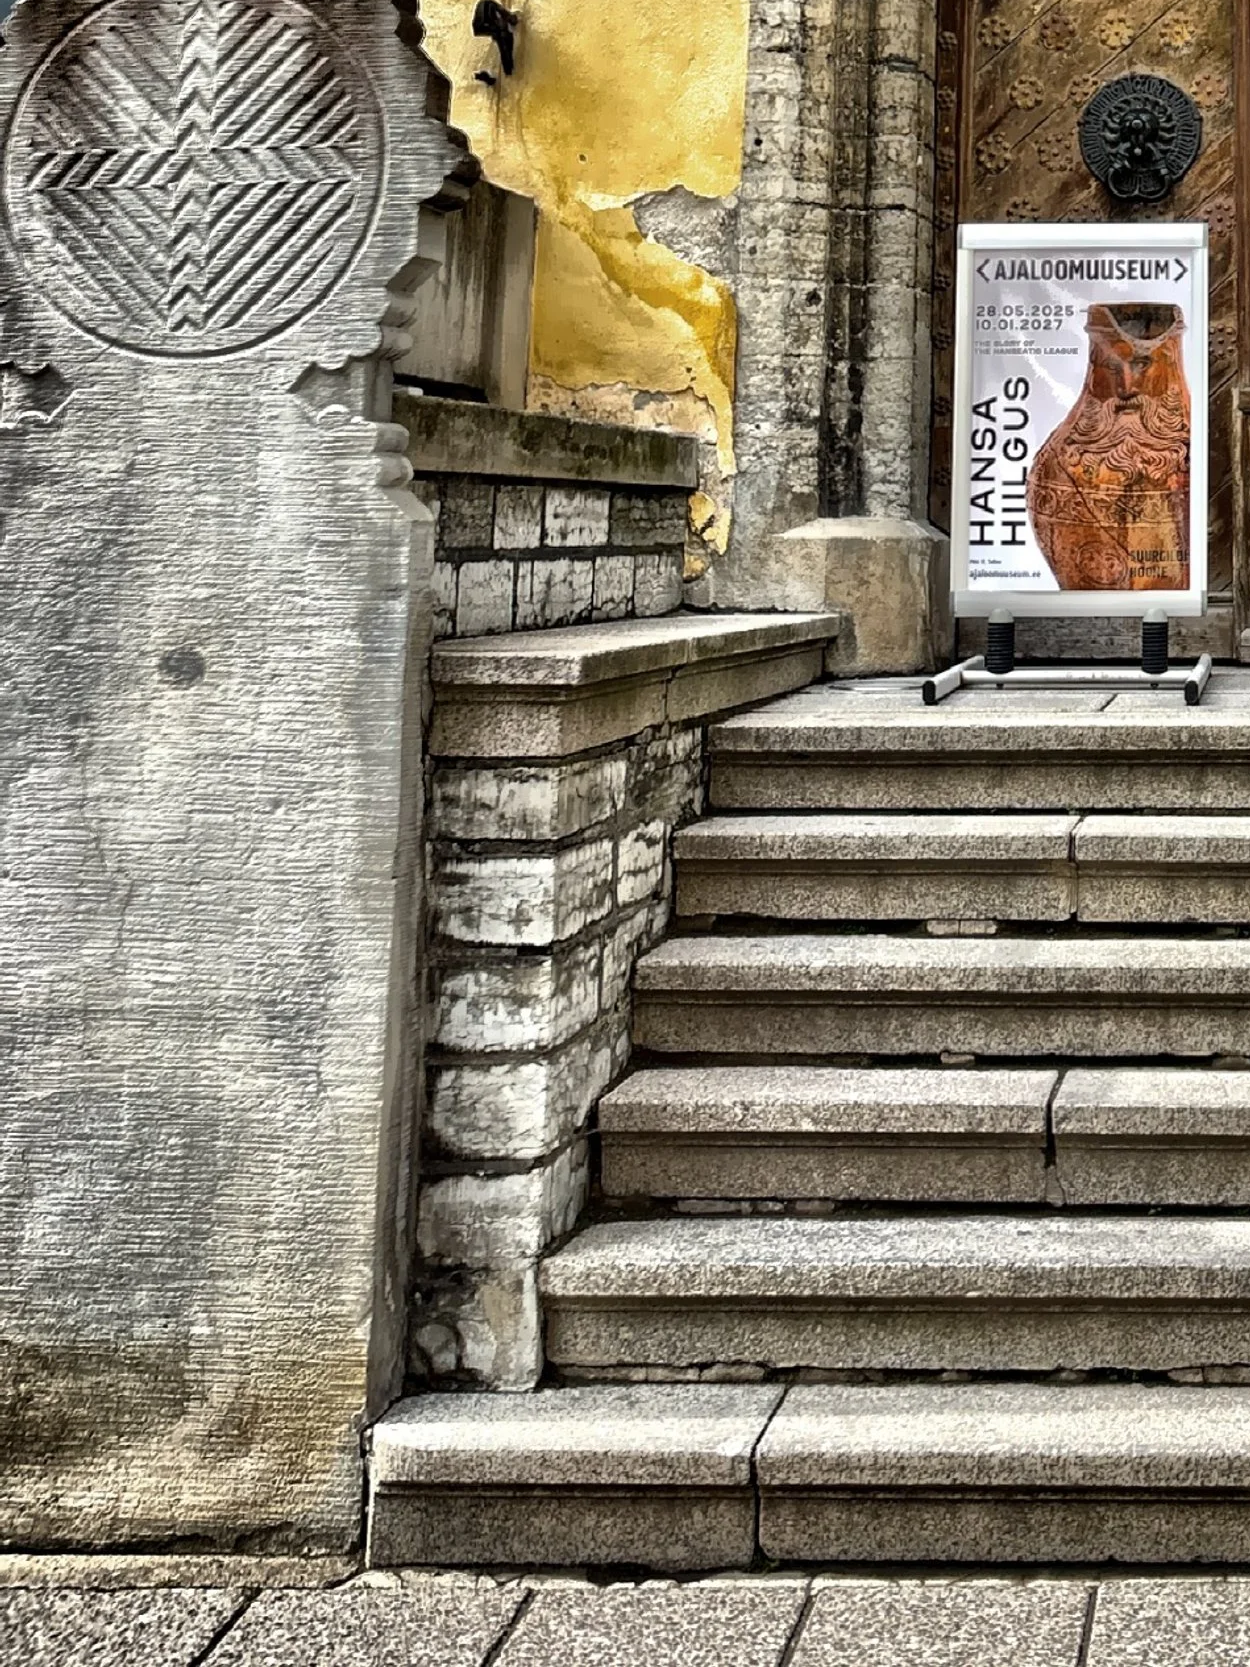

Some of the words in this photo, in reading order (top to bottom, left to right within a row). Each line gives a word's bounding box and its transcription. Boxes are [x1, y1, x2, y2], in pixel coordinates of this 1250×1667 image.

[994, 259, 1170, 281] AJALOOMUUSEUM
[976, 305, 1075, 318] 28.05.2025
[976, 318, 1063, 331] 10.01.2027
[1044, 347, 1079, 355] LEAGUE
[1001, 376, 1030, 546] HIILGUS
[969, 396, 998, 546] HANSA
